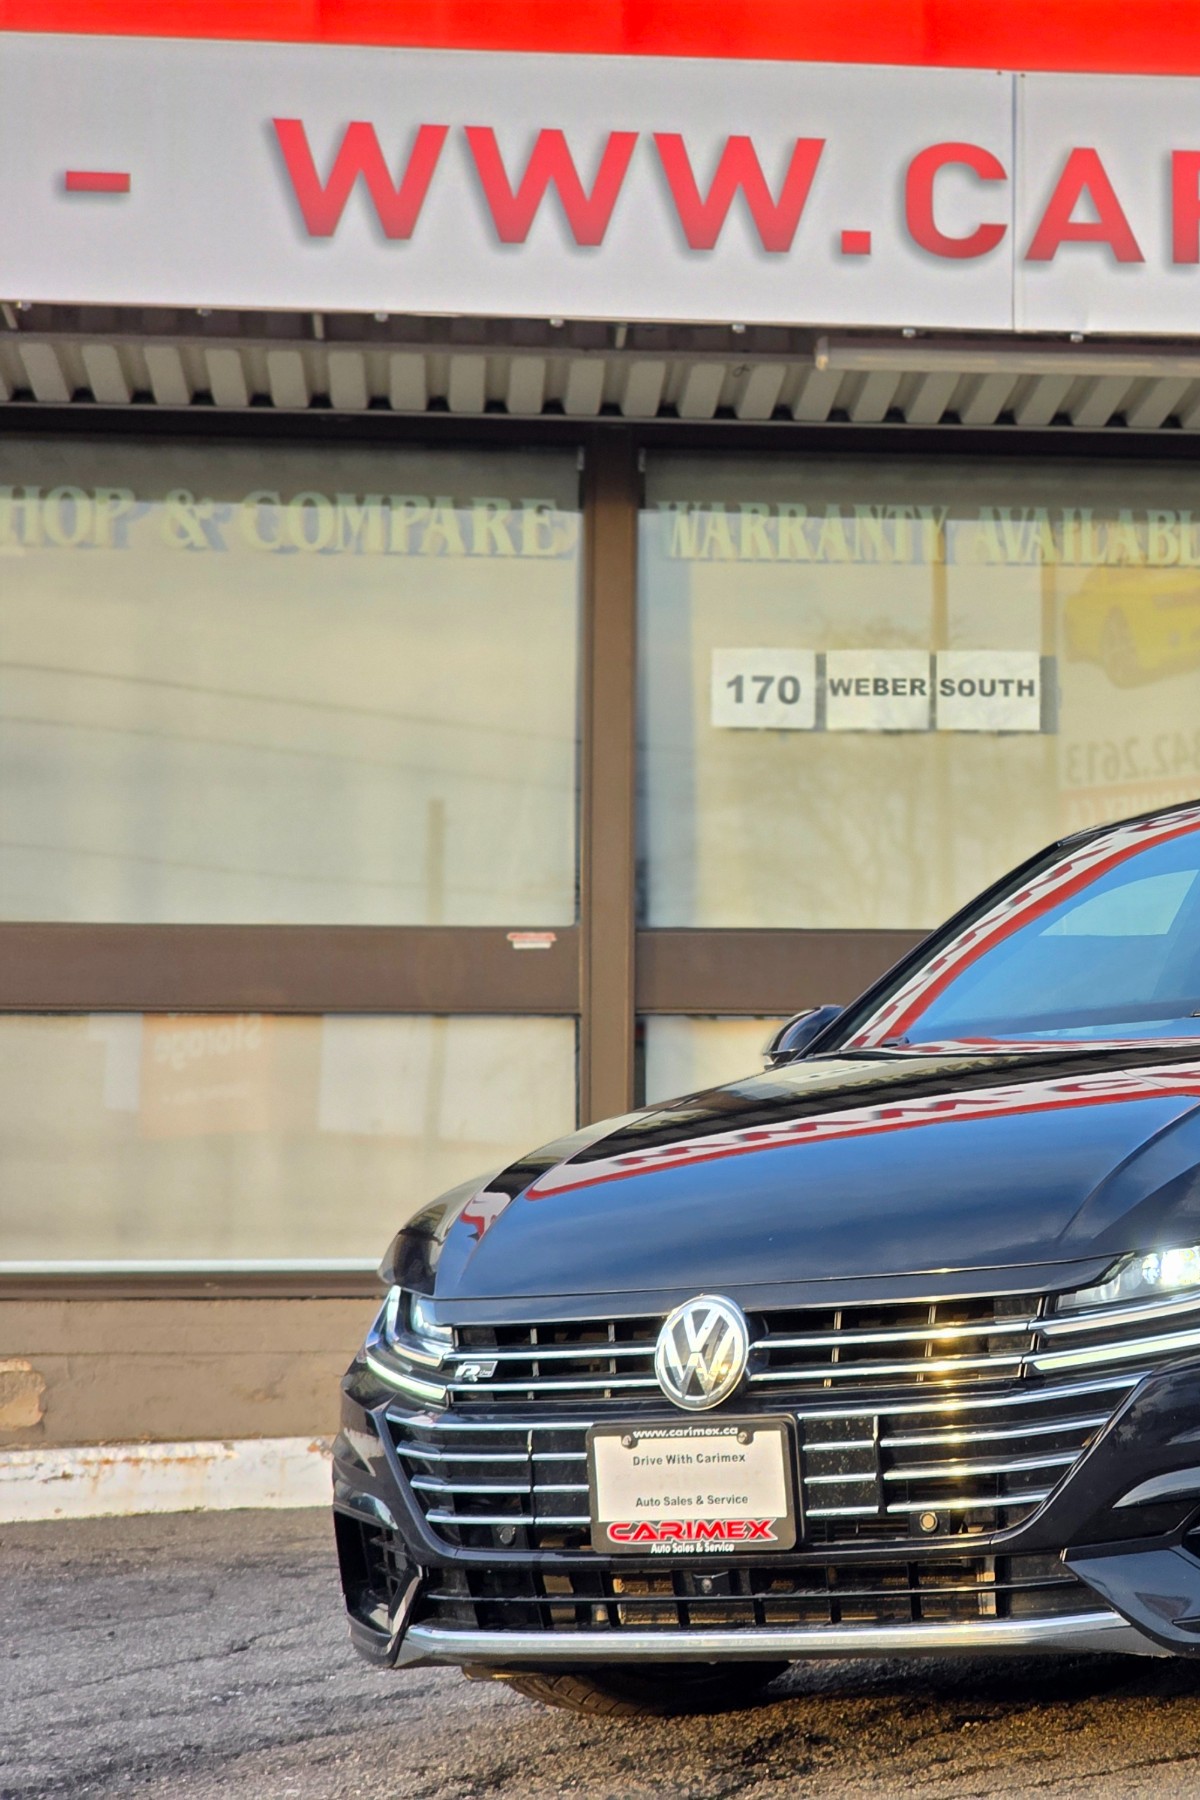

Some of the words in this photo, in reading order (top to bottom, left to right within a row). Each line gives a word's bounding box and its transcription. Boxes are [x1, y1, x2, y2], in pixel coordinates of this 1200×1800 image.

[162, 487, 213, 549] &
[240, 491, 564, 557] COMPARE
[658, 501, 948, 564] WARRANTY
[726, 675, 802, 705] 170
[829, 677, 927, 698] WEBER
[939, 677, 1035, 698] SOUTH
[633, 1427, 738, 1438] www.carimex.ca
[633, 1456, 662, 1466] Drive
[666, 1454, 692, 1464] With
[696, 1453, 745, 1463] Carimex
[636, 1497, 660, 1507] Auto
[664, 1496, 692, 1506] Sales
[696, 1496, 704, 1505] &
[707, 1494, 748, 1505] Service
[607, 1518, 777, 1543] CARIMEX
[651, 1543, 670, 1554] Auto
[672, 1542, 695, 1553] Sales
[696, 1542, 703, 1552] &
[704, 1541, 735, 1553] Service
